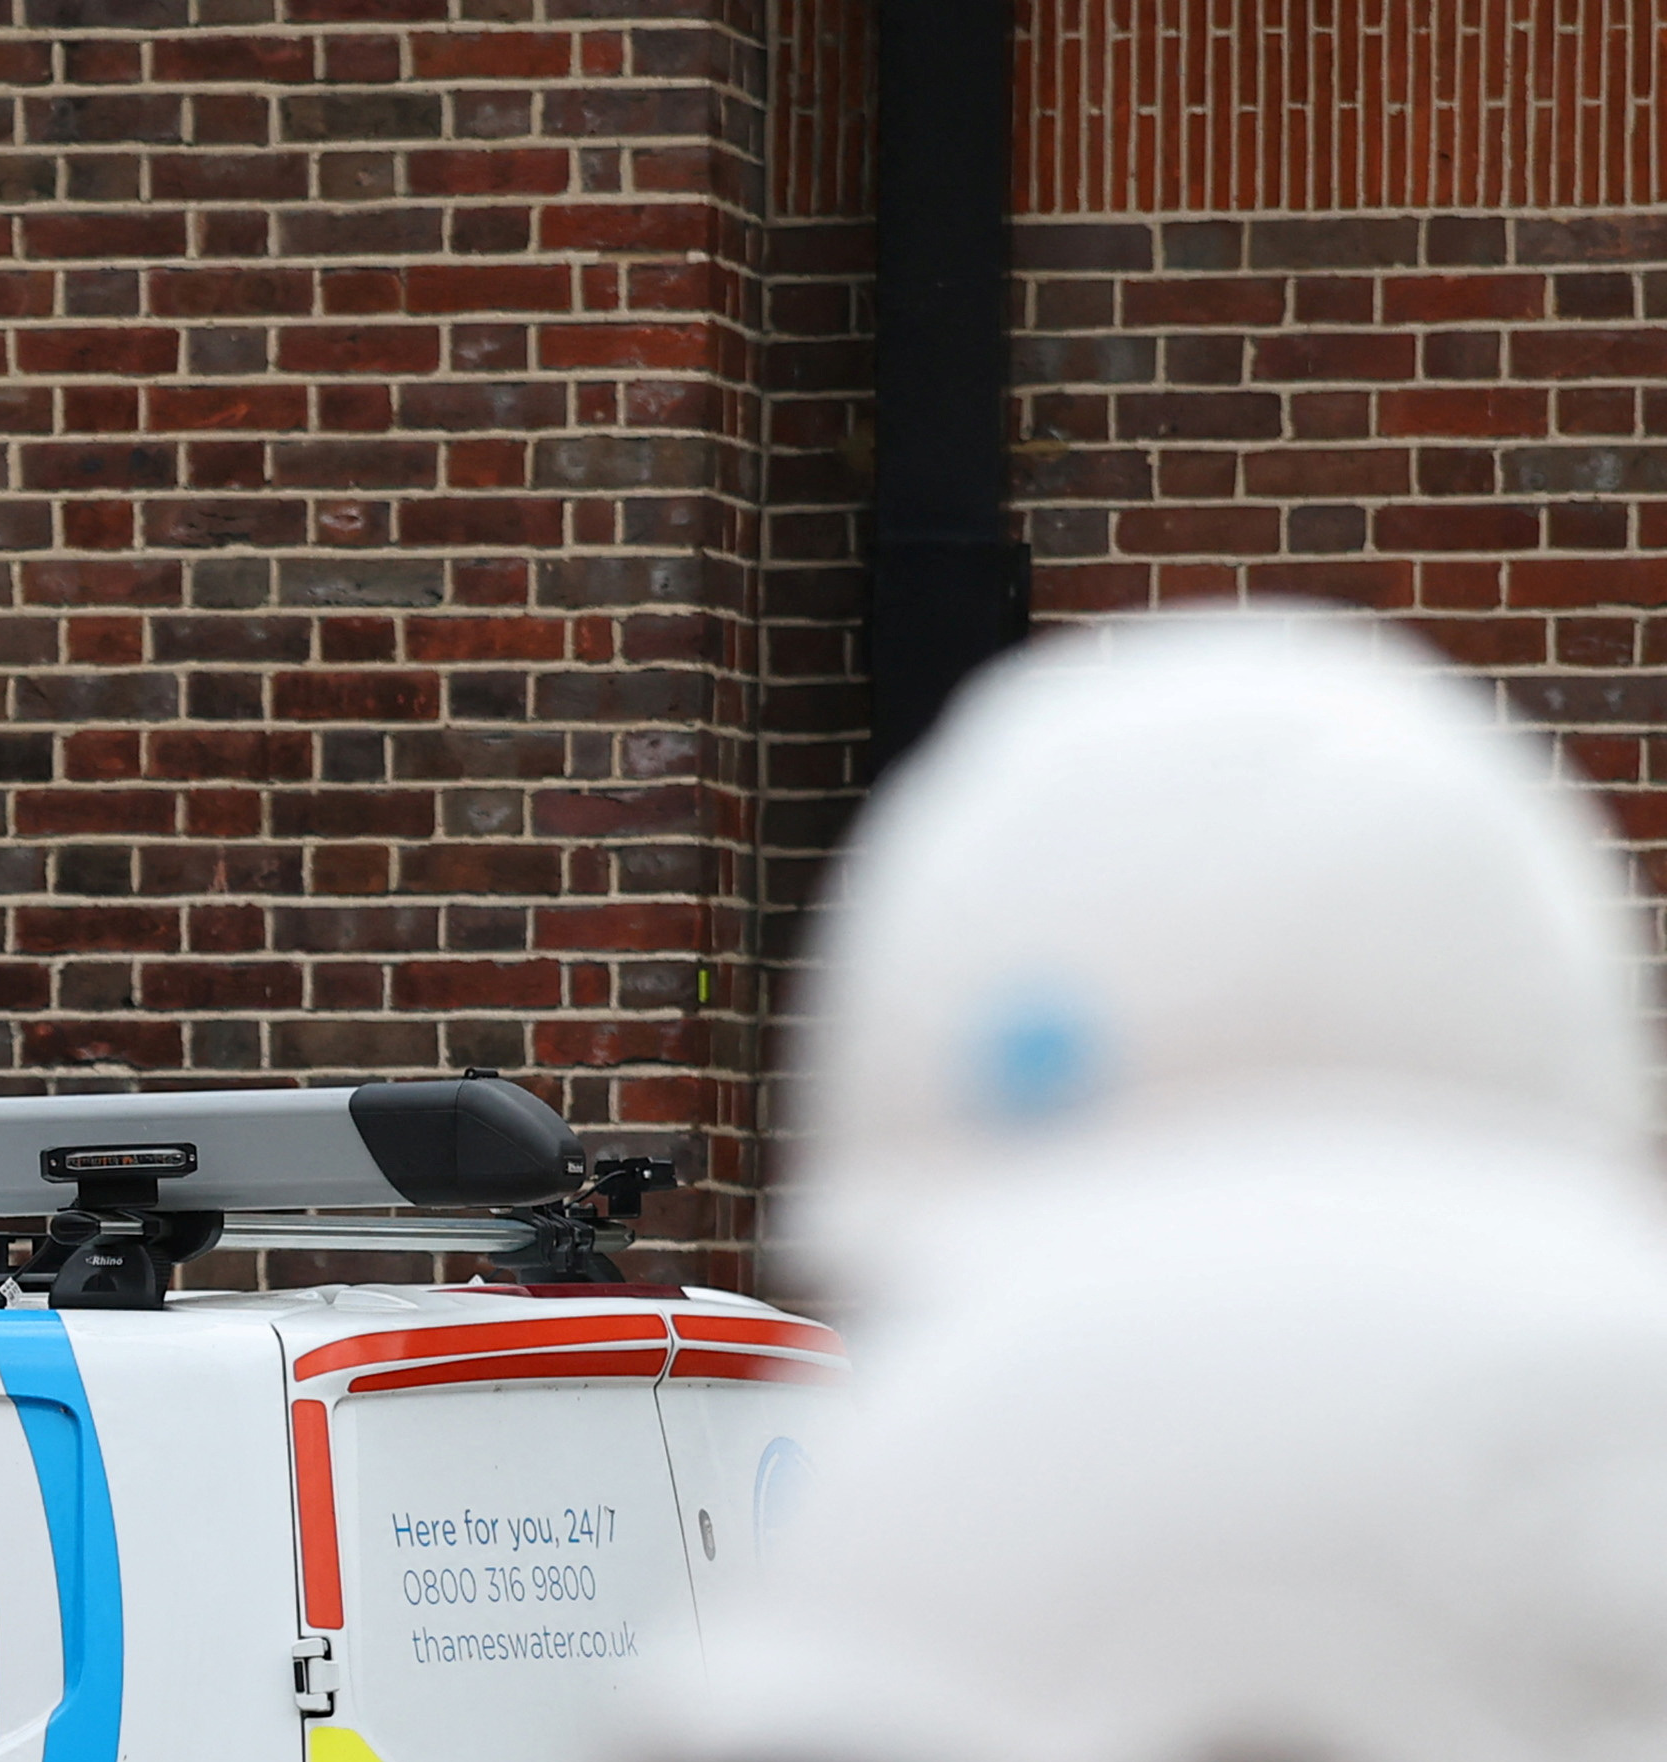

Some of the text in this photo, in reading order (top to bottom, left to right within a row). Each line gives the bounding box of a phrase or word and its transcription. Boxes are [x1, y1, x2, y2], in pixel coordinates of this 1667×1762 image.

[91, 1254, 124, 1266] Rhino
[392, 1503, 616, 1552] Here for you, 24/7
[403, 1564, 597, 1606] 0800 316 9800
[412, 1619, 640, 1664] thameswater.co.uk
